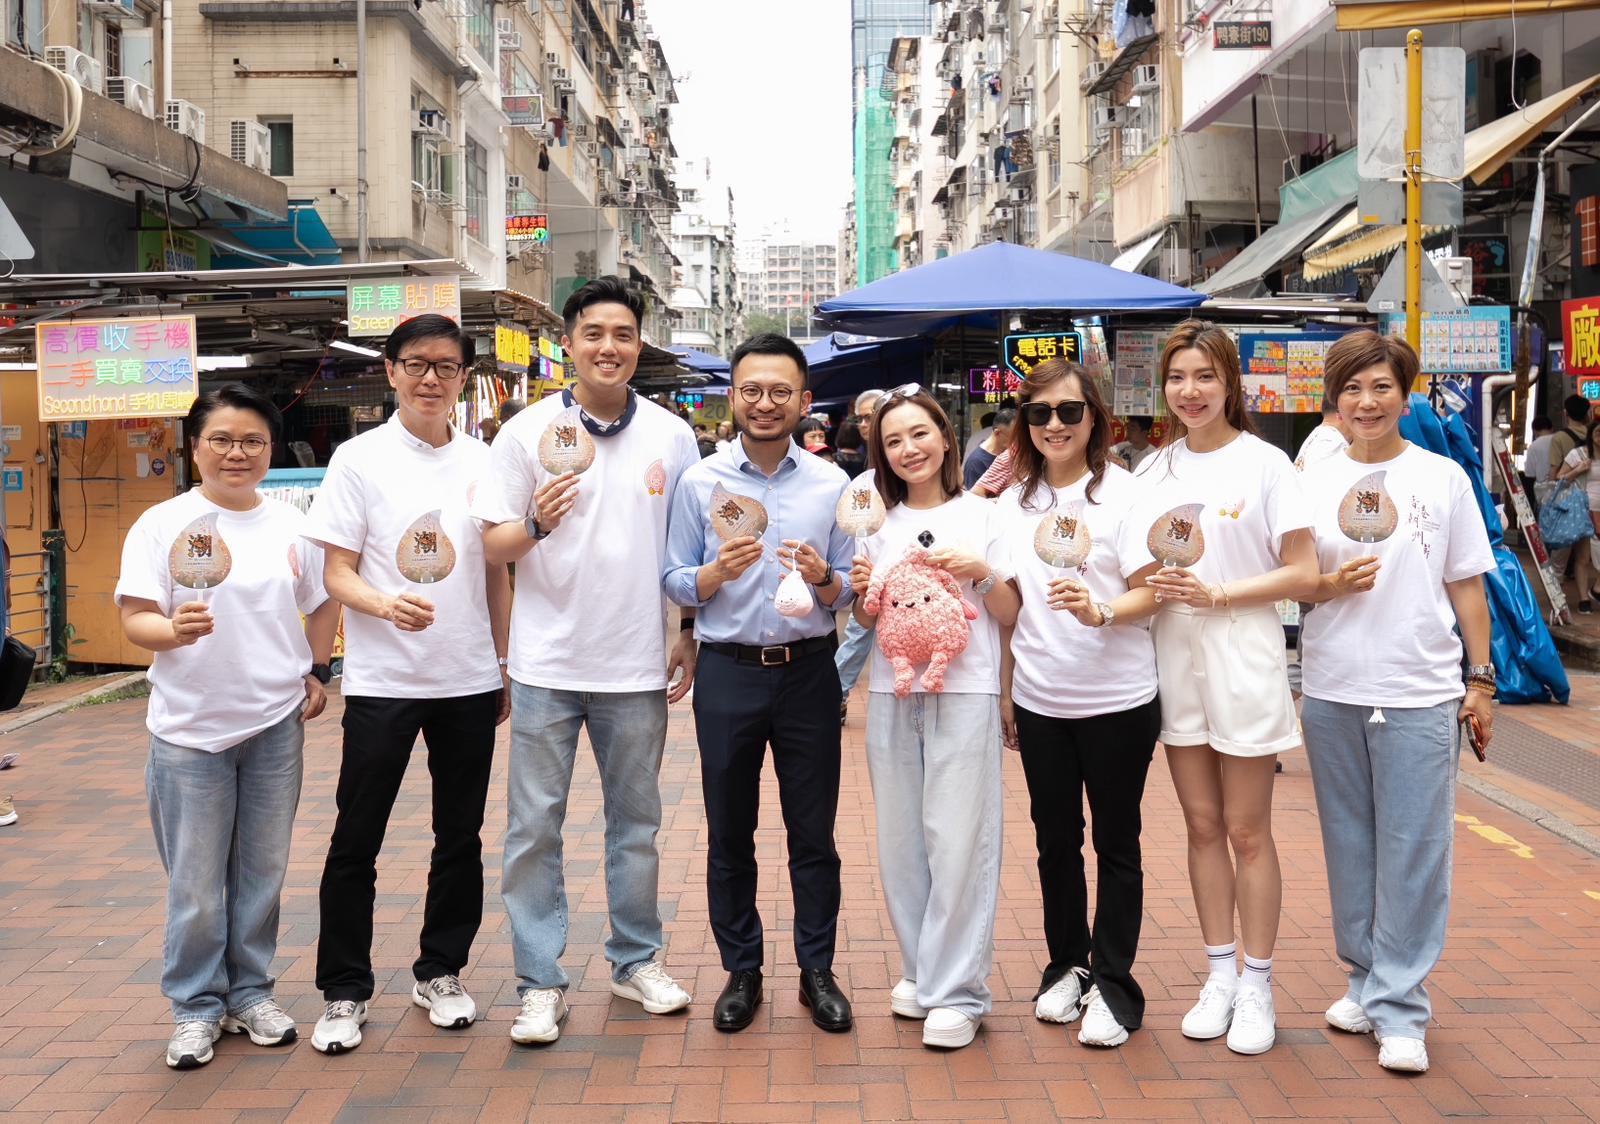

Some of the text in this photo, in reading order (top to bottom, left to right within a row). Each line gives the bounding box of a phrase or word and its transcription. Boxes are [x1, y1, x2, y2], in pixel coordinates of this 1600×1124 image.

[351, 283, 457, 312] 屏幕貼膜
[351, 315, 395, 331] Screen
[43, 322, 190, 354] 高價收手機
[1017, 336, 1075, 357] 電話卡
[46, 356, 194, 388] 二手買賣交換
[1582, 381, 1600, 399] 特
[44, 393, 126, 414] Secondhand
[704, 403, 726, 420] 20
